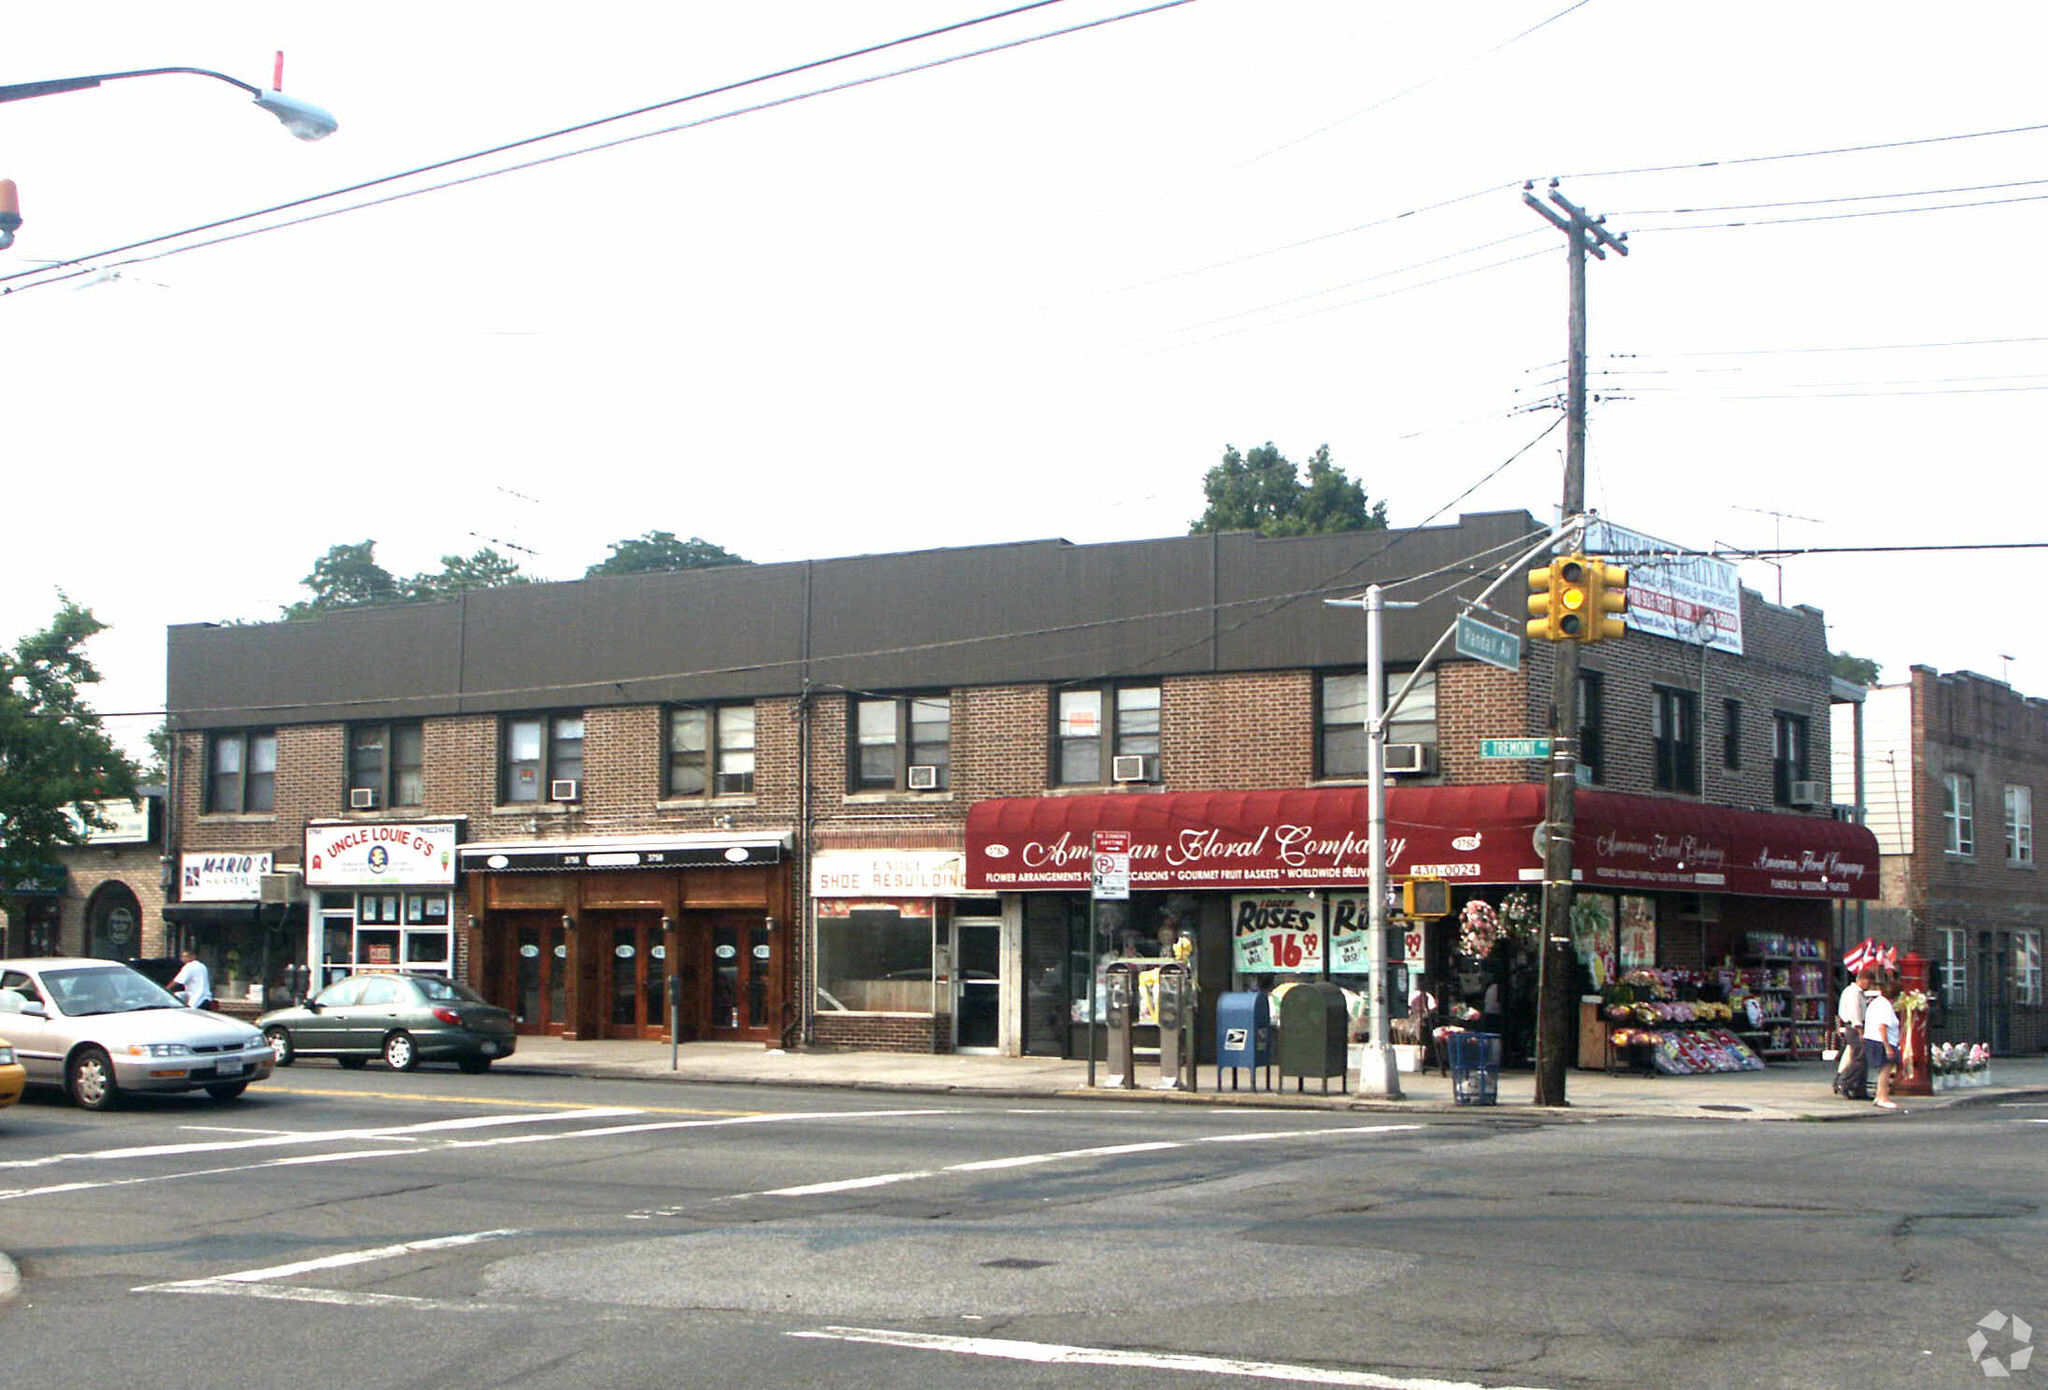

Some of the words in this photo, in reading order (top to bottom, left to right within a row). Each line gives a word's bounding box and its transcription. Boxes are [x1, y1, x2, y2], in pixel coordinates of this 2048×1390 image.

[1481, 740, 1488, 757] E
[1493, 740, 1536, 757] TREMONT
[327, 829, 368, 858] UNCLE
[372, 827, 411, 845] LOUIE
[413, 836, 434, 857] G'S
[1166, 826, 1270, 866] Floral
[202, 855, 268, 873] MARIO'S
[1415, 864, 1476, 877] 430-0024
[820, 874, 860, 889] SHOE
[985, 872, 1018, 882] FLOWER
[1018, 871, 1082, 882] ARRANGEMENTS
[1177, 869, 1220, 880] GOURMET
[1221, 869, 1242, 879] FRUIT
[1244, 868, 1279, 879] BASKETS
[1287, 867, 1341, 878] WORLDWIDE
[1235, 900, 1315, 936] ROSES
[1270, 934, 1302, 967] 16
[1302, 933, 1319, 951] 99
[1405, 934, 1421, 951] 99
